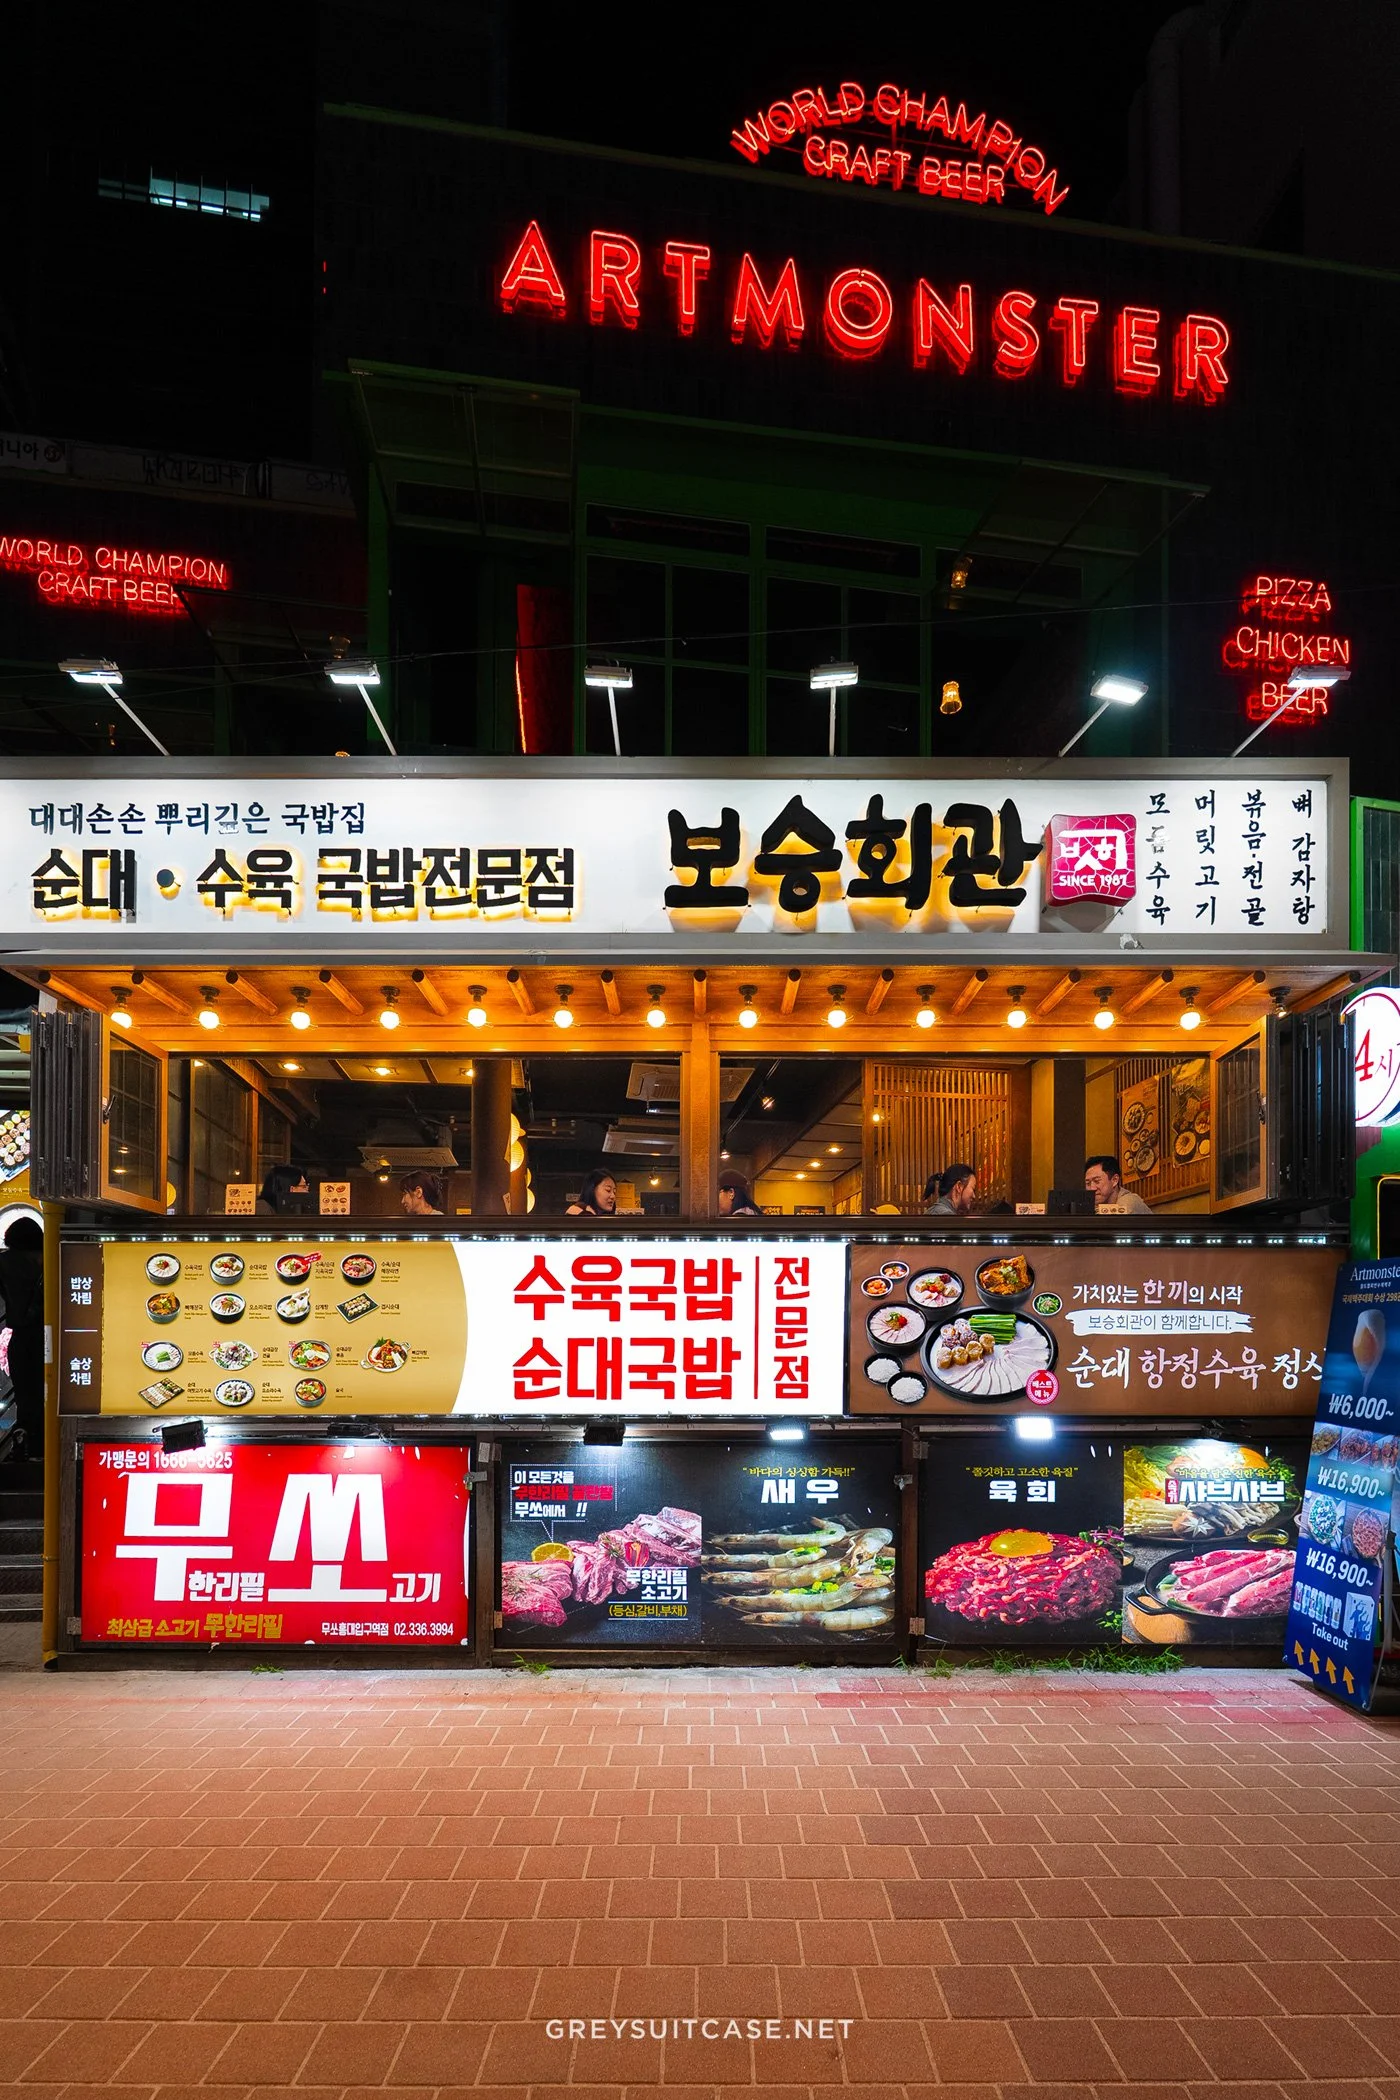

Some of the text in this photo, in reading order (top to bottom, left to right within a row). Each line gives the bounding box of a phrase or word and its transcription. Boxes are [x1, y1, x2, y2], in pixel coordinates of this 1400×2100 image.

[731, 81, 1069, 214] WORLD CHAMPION
[803, 136, 1006, 203] CRAFT BEER
[500, 220, 1230, 396] ARTMONSTER
[0, 536, 226, 586] WORLD CHAMPION
[38, 570, 118, 600] CRAFT
[1255, 576, 1332, 612] PIZZA
[1236, 626, 1350, 665] CHICKEN
[29, 802, 144, 836] 대대손손
[281, 802, 366, 836] 국밥집
[663, 792, 1044, 912] 보승회관
[1195, 789, 1220, 926] 머릿고기
[1291, 789, 1316, 926] 뼈감자탕
[31, 846, 575, 911] 순대 수육 국밥전문점
[1059, 875, 1128, 887] SINCE 1987
[70, 1276, 93, 1290] 밥상
[513, 1254, 742, 1322] 수육국밥
[1072, 1284, 1139, 1305] 가치있는
[1142, 1278, 1165, 1305] 한
[1208, 1285, 1244, 1306] 시작
[70, 1291, 93, 1305] 차림
[773, 1256, 811, 1400] 전문점
[1088, 1314, 1233, 1331] 보승회관이 함께합니다.
[69, 1357, 93, 1371] 술상
[512, 1336, 742, 1401] 순대국밥
[1066, 1345, 1132, 1390] 순대
[1138, 1345, 1267, 1391] 항정수육
[70, 1372, 93, 1386] 차림
[99, 1449, 151, 1469] 가맹문의
[1017, 1466, 1050, 1477] 고소한
[514, 1471, 575, 1484] 이 모든것을
[1179, 1479, 1286, 1503] 샤브샤브
[515, 1502, 566, 1518] 무쏘에서
[626, 1570, 688, 1585] 무한리필
[641, 1585, 688, 1601] 소고기
[154, 1619, 200, 1638] 소고기
[204, 1613, 284, 1640] 무한리필
[393, 1622, 454, 1637] 02.336.3994
[1311, 1622, 1349, 1651] Take out
